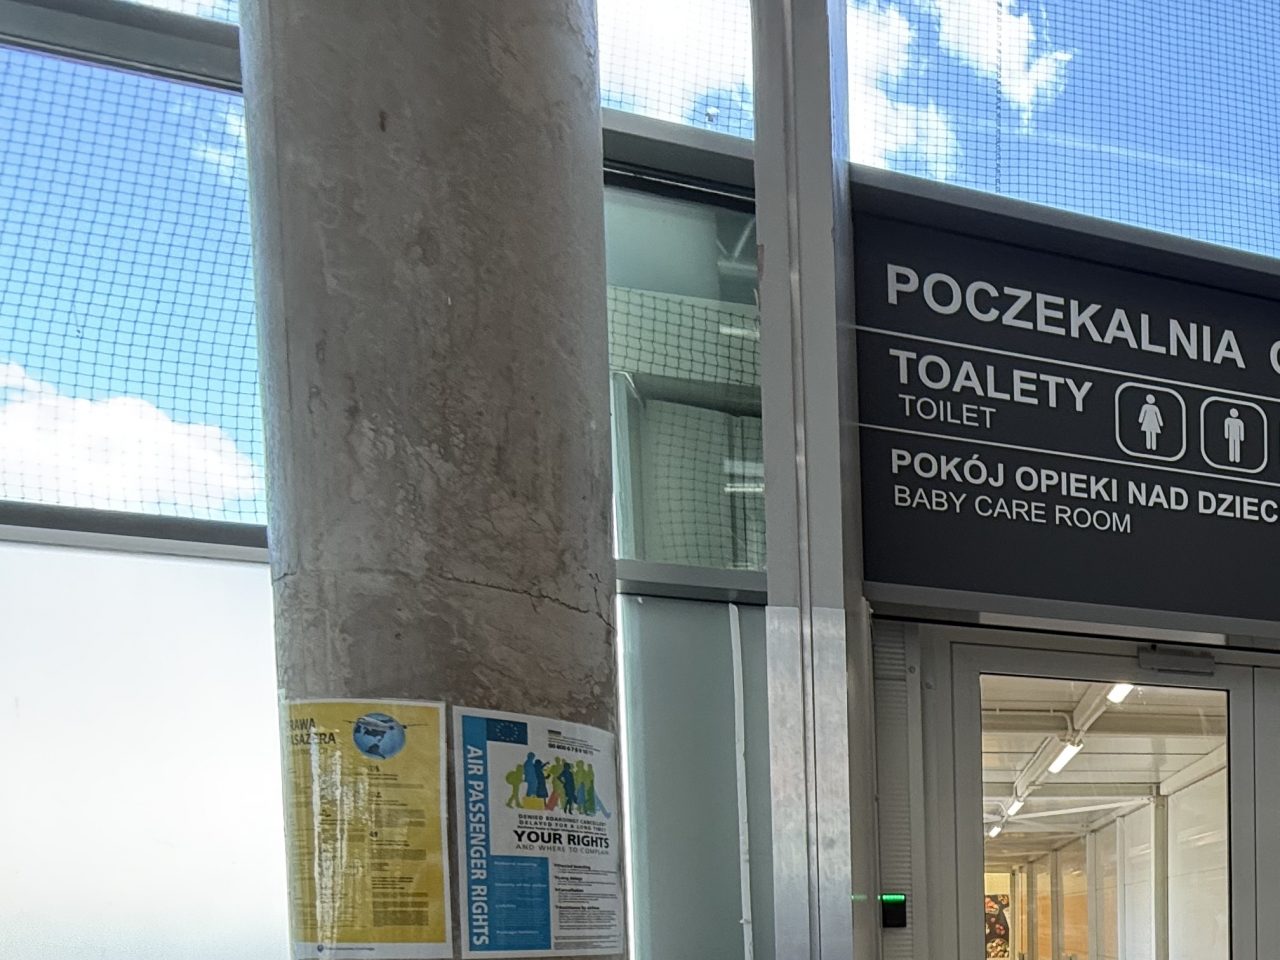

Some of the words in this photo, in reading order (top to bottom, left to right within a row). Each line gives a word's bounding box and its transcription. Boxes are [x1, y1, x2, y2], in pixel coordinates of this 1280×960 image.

[887, 264, 1246, 369] POCZEKALNIA
[889, 348, 1093, 412] TOALETY
[898, 394, 997, 429] TOILET
[891, 448, 1004, 488] POKÓJ
[1015, 466, 1118, 502] OPIEKI
[1128, 480, 1189, 511] NAD
[894, 485, 967, 513] BABY
[974, 495, 1047, 524] CARE
[1055, 505, 1132, 533] ROOM
[466, 745, 484, 775] AIR
[468, 780, 487, 880] PASSENGER
[513, 829, 563, 845] YOUR
[567, 833, 610, 849] RIGHTS
[471, 885, 489, 946] RIGHTS
